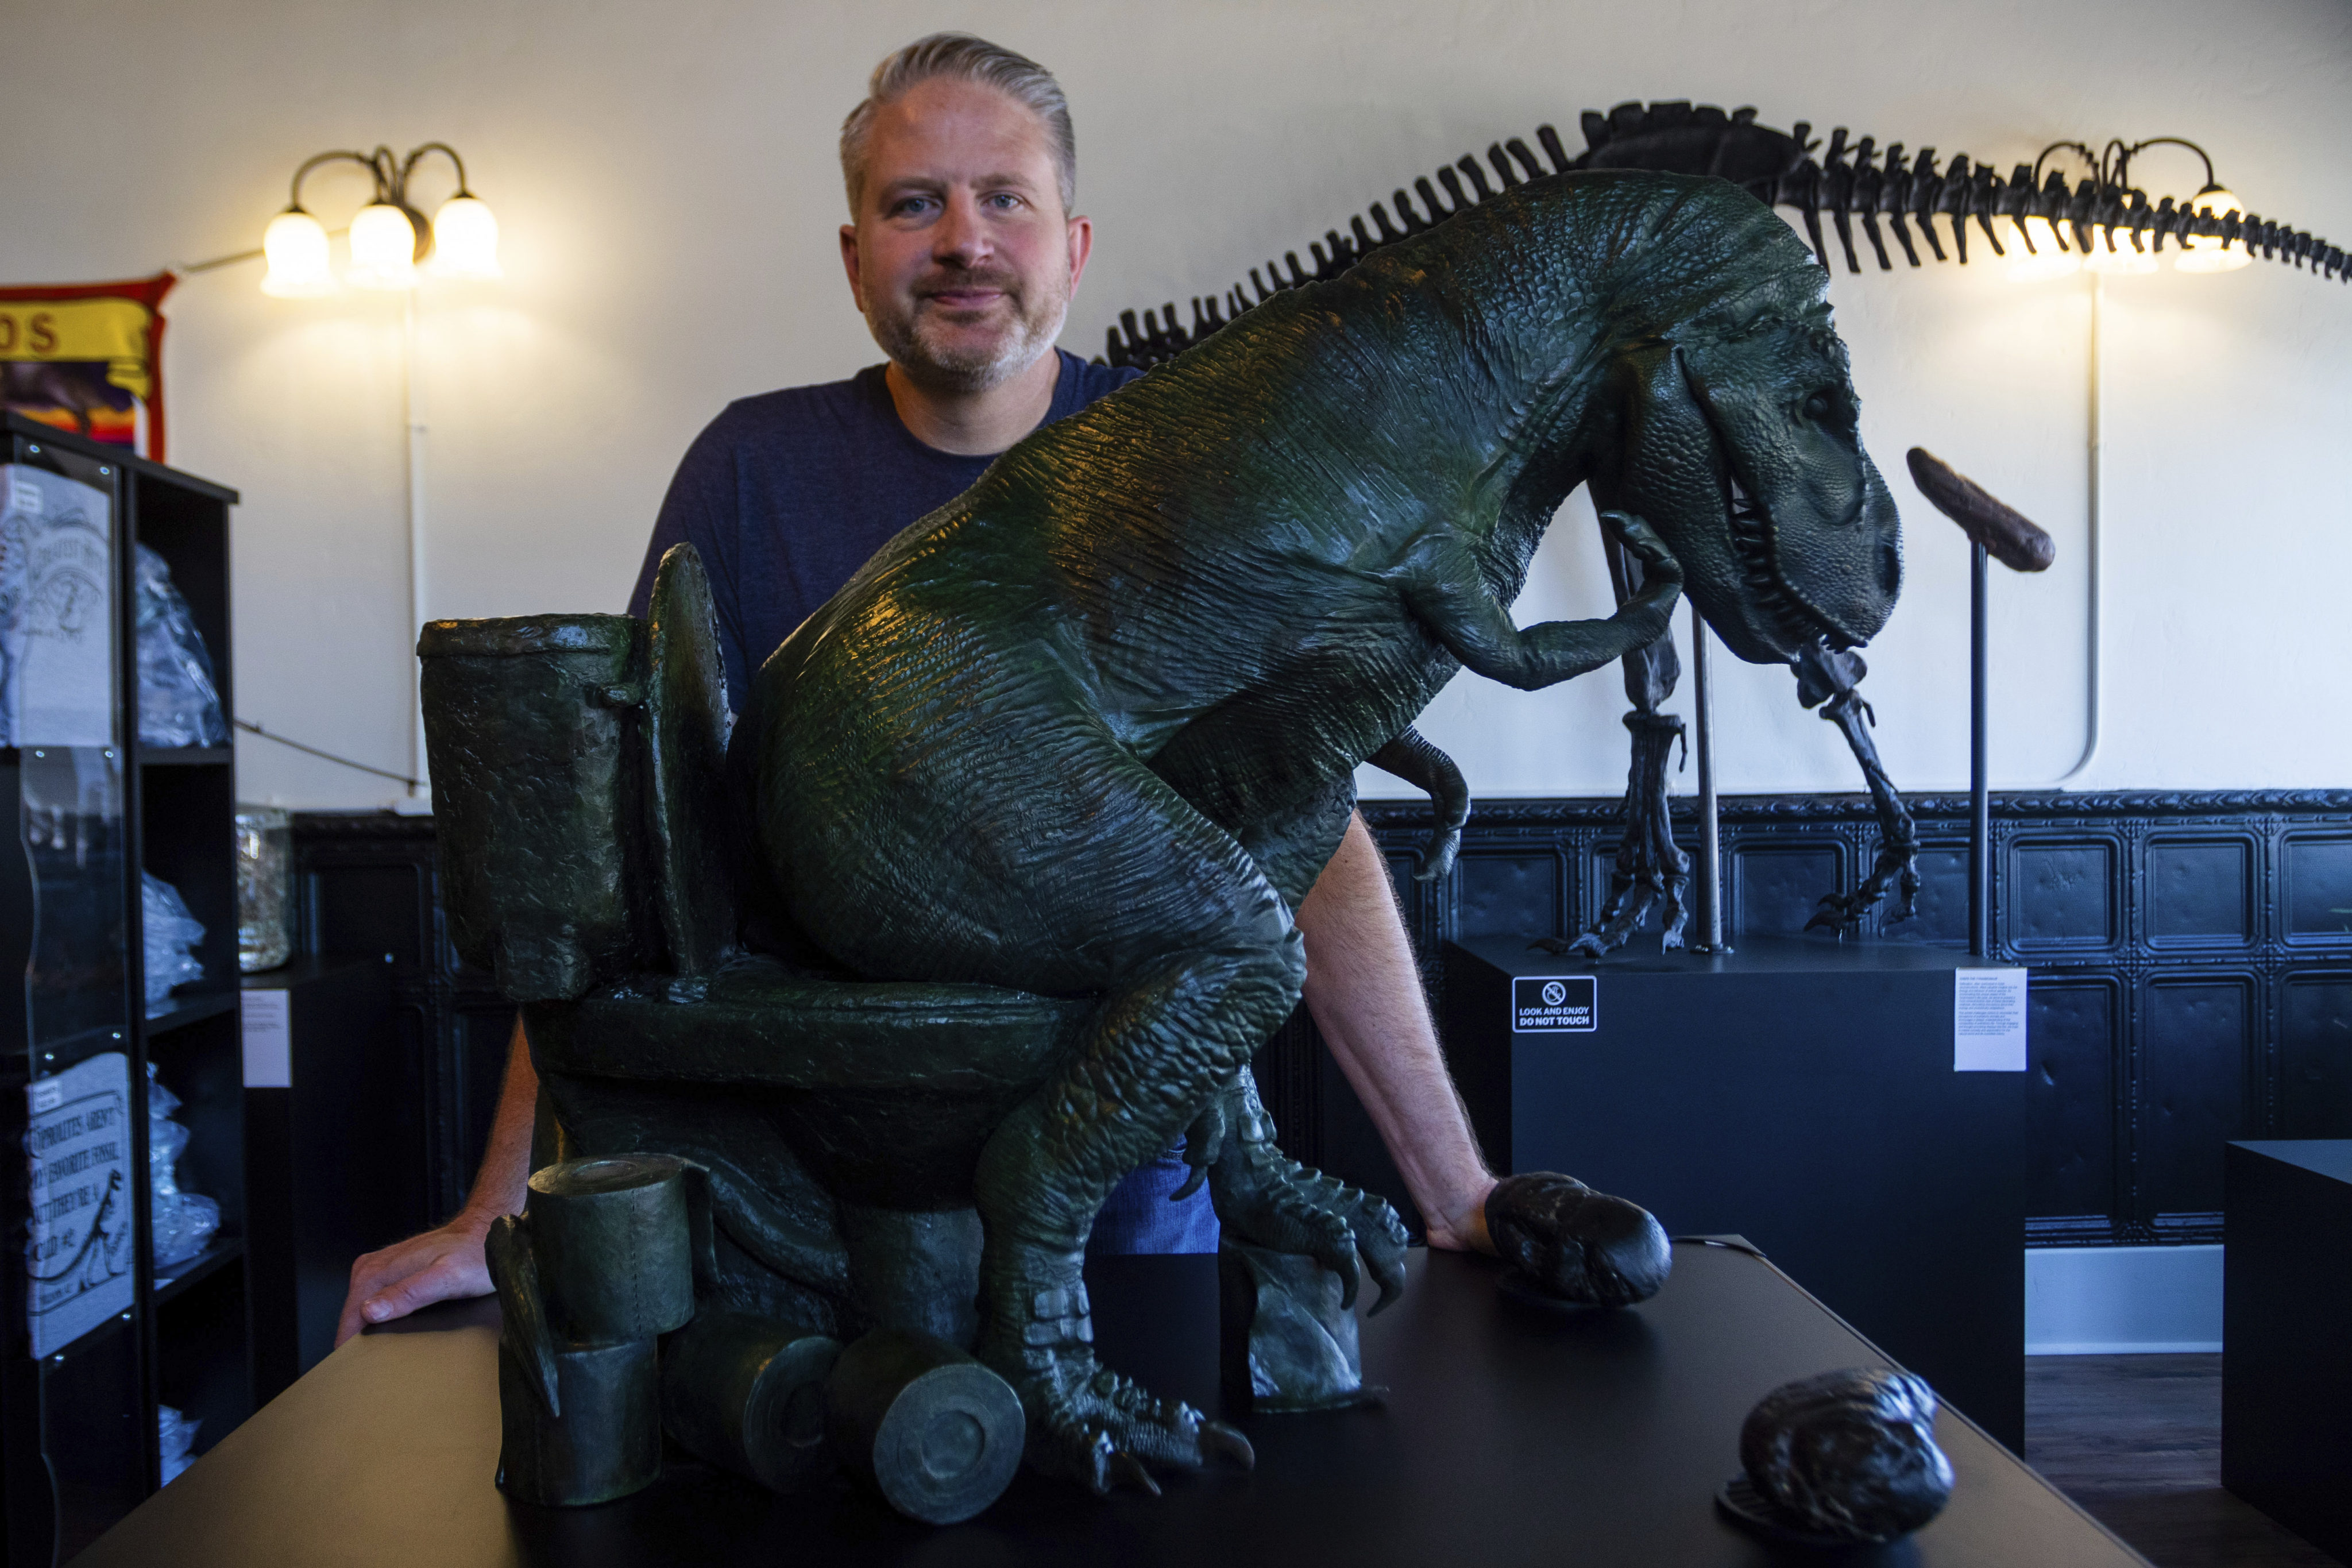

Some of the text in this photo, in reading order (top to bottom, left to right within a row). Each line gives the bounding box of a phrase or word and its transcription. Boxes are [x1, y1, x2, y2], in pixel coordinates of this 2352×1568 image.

[1519, 1006, 1589, 1016] LOOK AND ENJOY
[1519, 1016, 1589, 1026] DO NOT TOUCH
